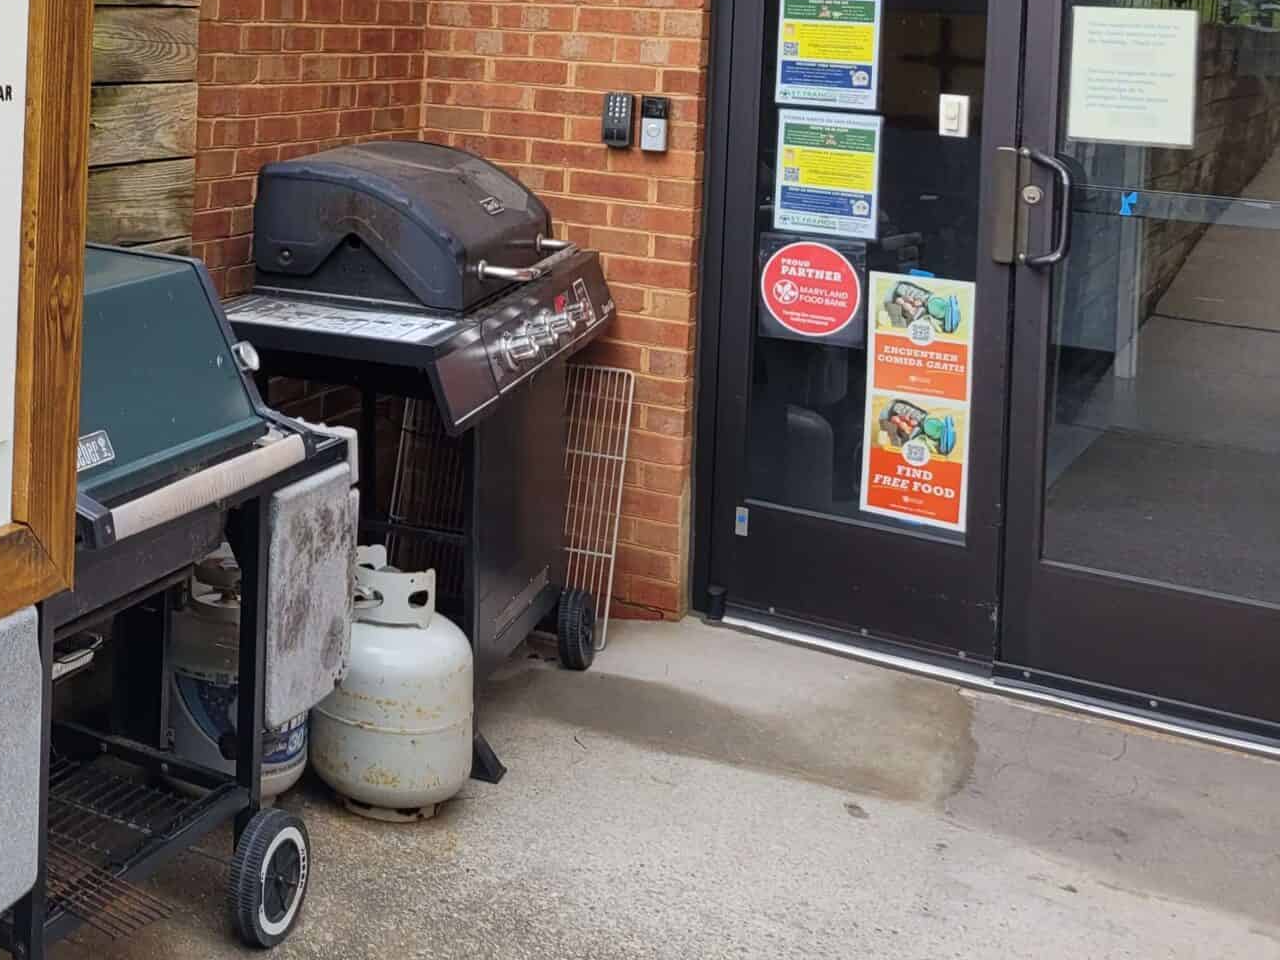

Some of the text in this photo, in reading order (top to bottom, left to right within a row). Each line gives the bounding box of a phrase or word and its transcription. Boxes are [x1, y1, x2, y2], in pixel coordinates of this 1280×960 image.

[781, 257, 810, 267] PROUD
[781, 265, 842, 282] PARTNER
[800, 286, 848, 299] MARYLAND
[800, 294, 848, 307] FOOD BANK
[878, 354, 965, 373] COMIDA GRATIS
[896, 465, 933, 481] FIND
[873, 474, 955, 499] FREE FOOD
